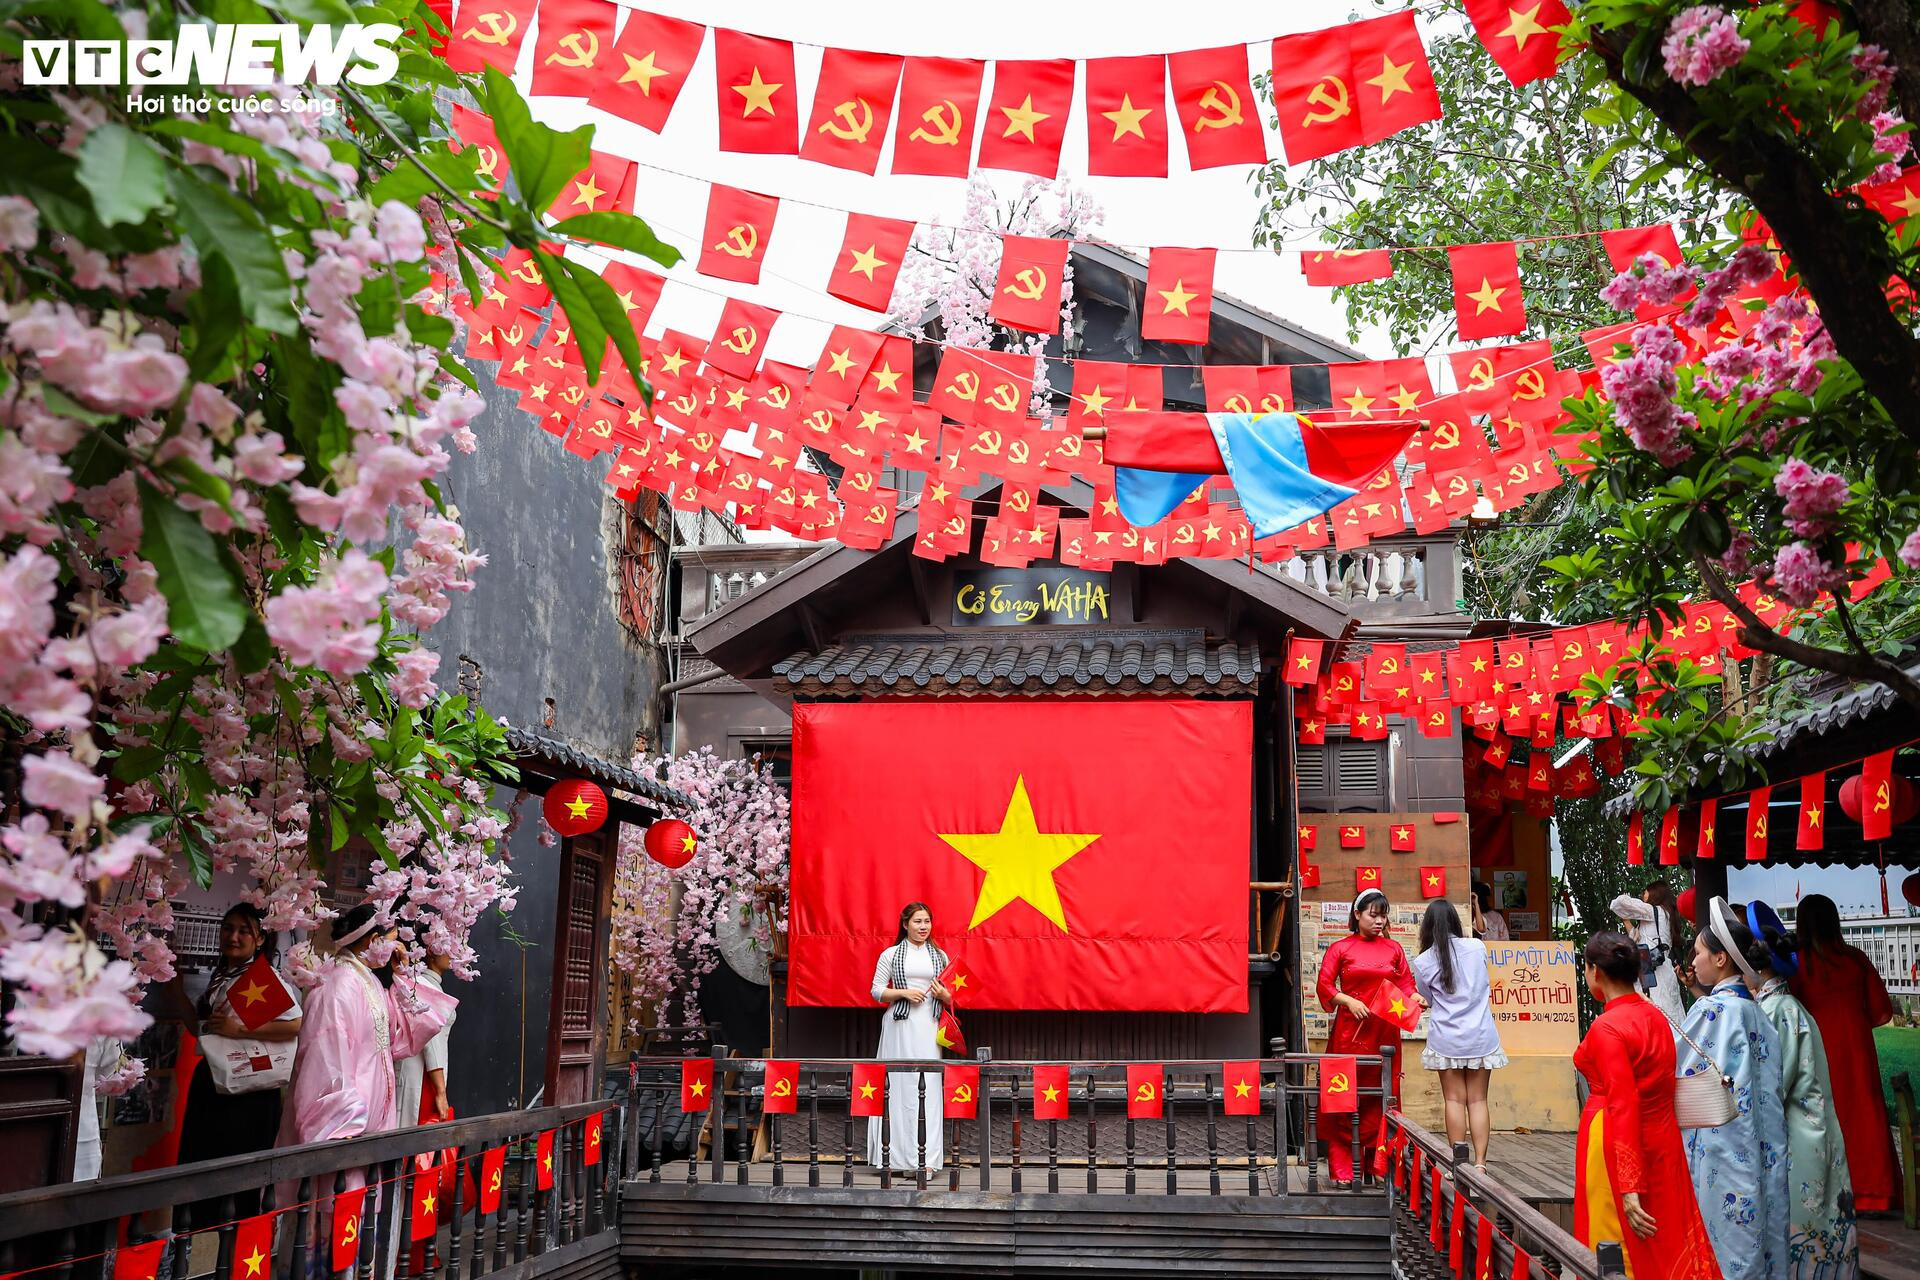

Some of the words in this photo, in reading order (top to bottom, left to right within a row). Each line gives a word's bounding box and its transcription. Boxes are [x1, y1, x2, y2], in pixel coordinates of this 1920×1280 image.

[1037, 577, 1110, 621] WAHA
[1488, 950, 1514, 968] HỤP
[1515, 946, 1545, 968] MỘT
[1547, 944, 1575, 966] LẦN
[1505, 985, 1538, 1007] MỘT
[1531, 1012, 1576, 1023] 30/4/2025
